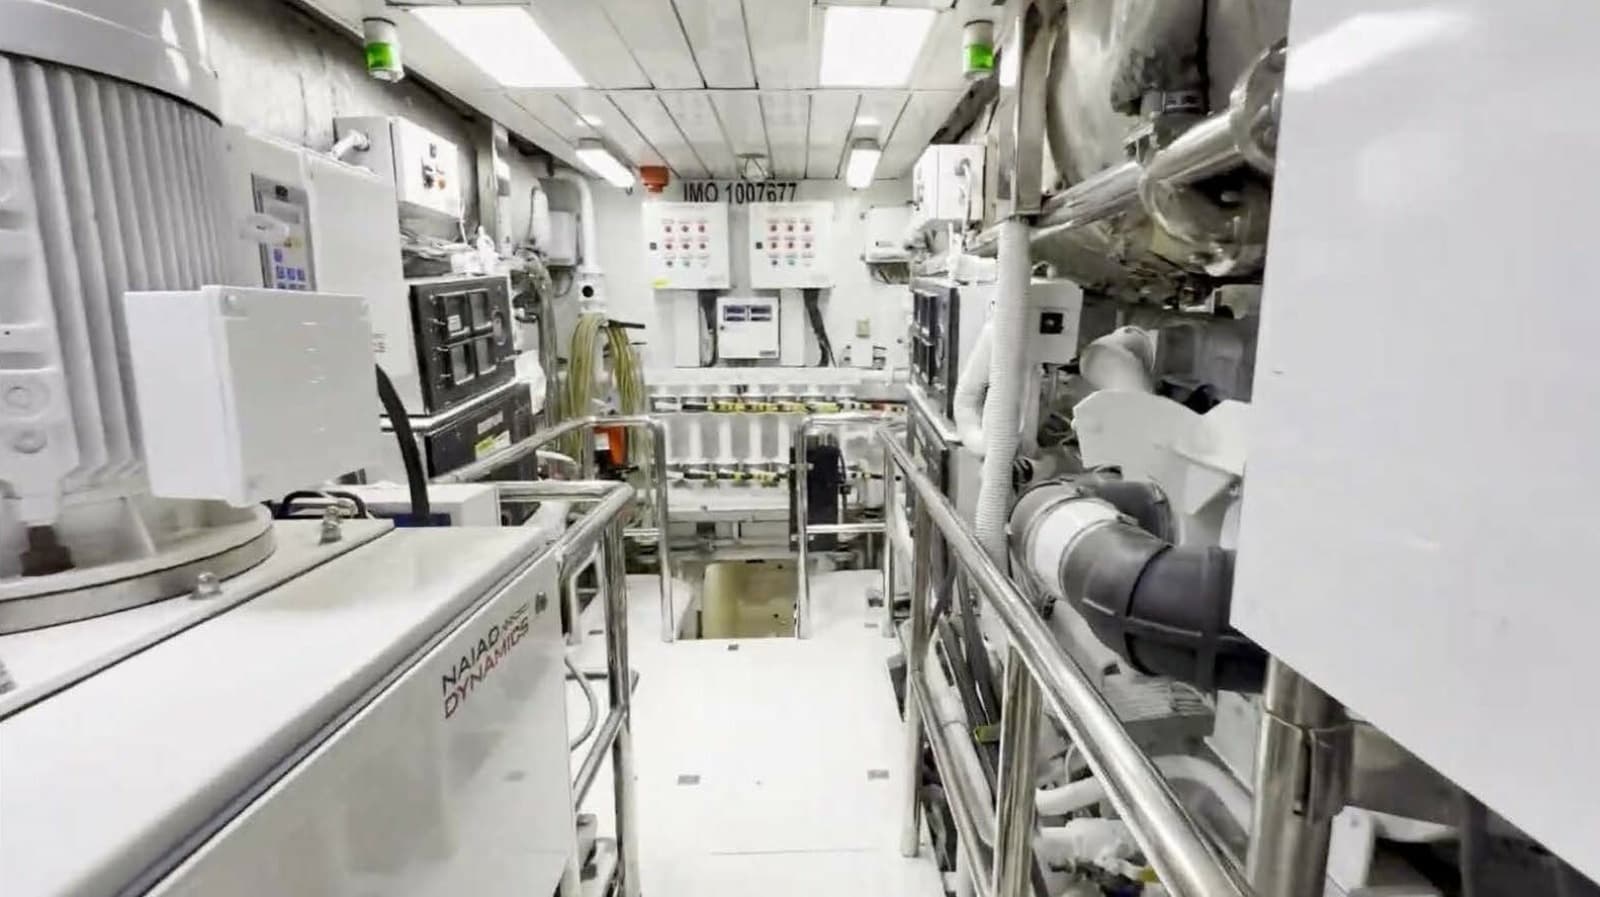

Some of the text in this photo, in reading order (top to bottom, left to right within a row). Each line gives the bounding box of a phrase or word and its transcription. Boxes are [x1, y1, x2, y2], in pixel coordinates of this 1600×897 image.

[683, 182, 797, 204] IMO 1007677
[442, 625, 500, 695] NAIAD
[445, 616, 529, 719] DYNAMICS
